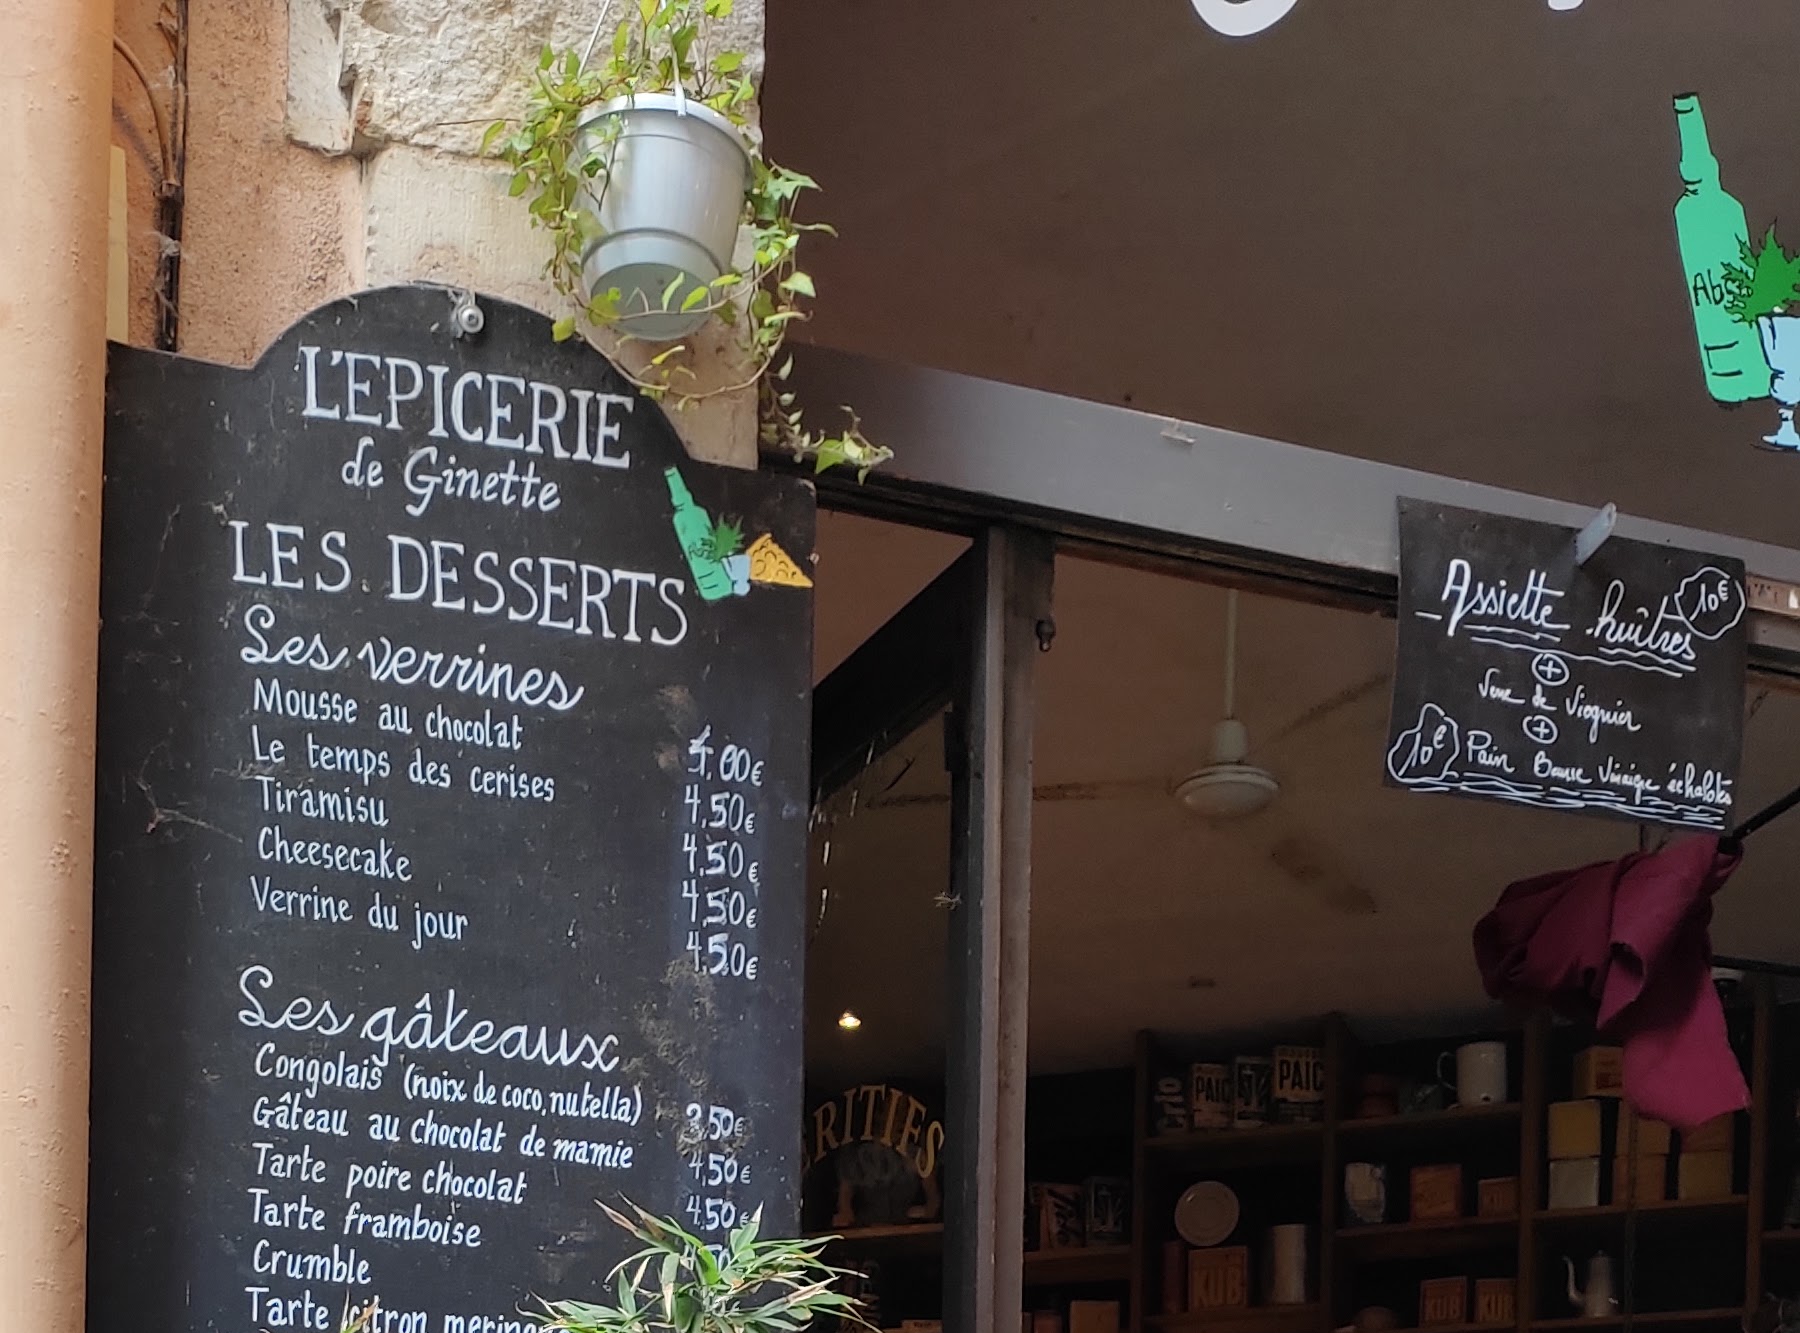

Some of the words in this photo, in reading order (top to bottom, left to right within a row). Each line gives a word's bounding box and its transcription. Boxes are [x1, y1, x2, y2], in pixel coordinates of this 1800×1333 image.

[301, 345, 634, 469] L'EPICERIE
[342, 436, 385, 487] de
[404, 446, 561, 515] Ginette
[230, 520, 353, 592] LES
[388, 535, 688, 646] DESSERTS
[1441, 557, 1571, 636] Assiette
[241, 602, 350, 669] Les
[358, 636, 584, 711] verrines
[254, 678, 358, 724] Mousse
[379, 706, 412, 736] au
[425, 708, 524, 752] chocolat
[1467, 730, 1515, 772] Pain
[252, 726, 285, 763] Le
[307, 732, 391, 785] temps
[408, 748, 452, 788] des
[470, 765, 556, 803] cerises
[256, 776, 389, 828] Tiramisu
[258, 826, 412, 883] Cheesecake
[251, 876, 354, 922] Verrine
[368, 896, 400, 932] du
[412, 902, 469, 949] jour
[239, 964, 356, 1037] Les
[361, 989, 620, 1073] gâteaux
[255, 1042, 382, 1097] Congolais
[404, 1063, 467, 1102] (noix
[473, 1070, 497, 1105] de
[1278, 1059, 1324, 1091] PAIC
[252, 1092, 349, 1138] Gâteau
[369, 1111, 400, 1141] au
[411, 1110, 507, 1154] chocolat
[520, 1124, 546, 1157] de
[554, 1137, 634, 1169] mamie
[802, 1084, 945, 1179] RITIES
[253, 1143, 327, 1183] Tarte
[346, 1161, 412, 1199] poire
[423, 1160, 528, 1206] chocolat
[248, 1189, 326, 1232] Tarte
[343, 1202, 482, 1248] framboise
[253, 1239, 372, 1285] Crumble
[244, 1286, 330, 1331] Tarte
